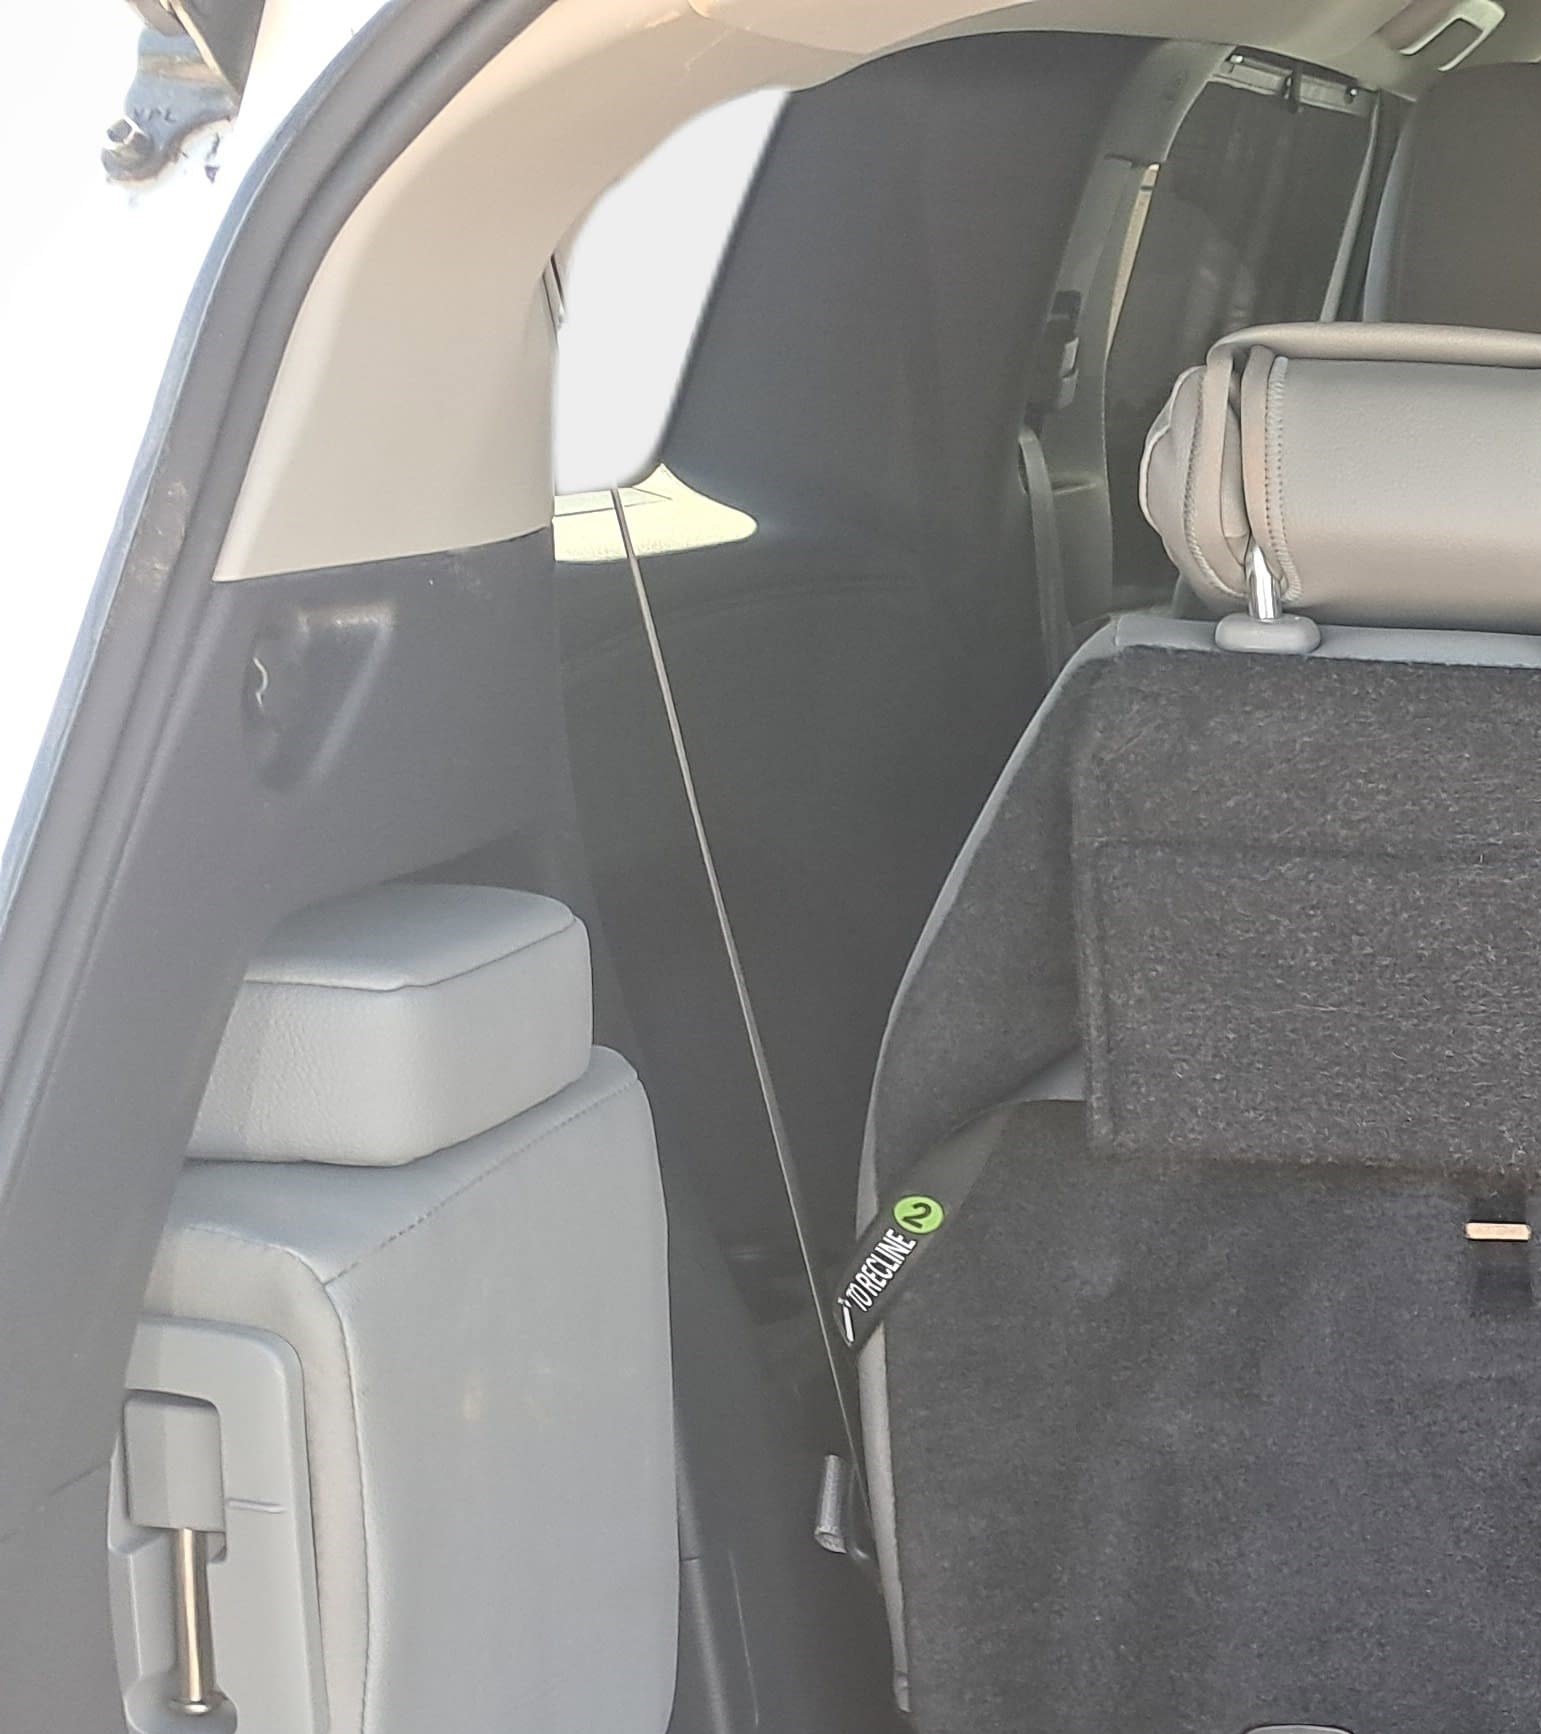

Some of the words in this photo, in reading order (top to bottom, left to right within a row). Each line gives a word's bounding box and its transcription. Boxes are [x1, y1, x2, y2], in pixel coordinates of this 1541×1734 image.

[902, 1202, 932, 1229] 2
[855, 1228, 917, 1297] RECLINE
[845, 1281, 873, 1312] TO
